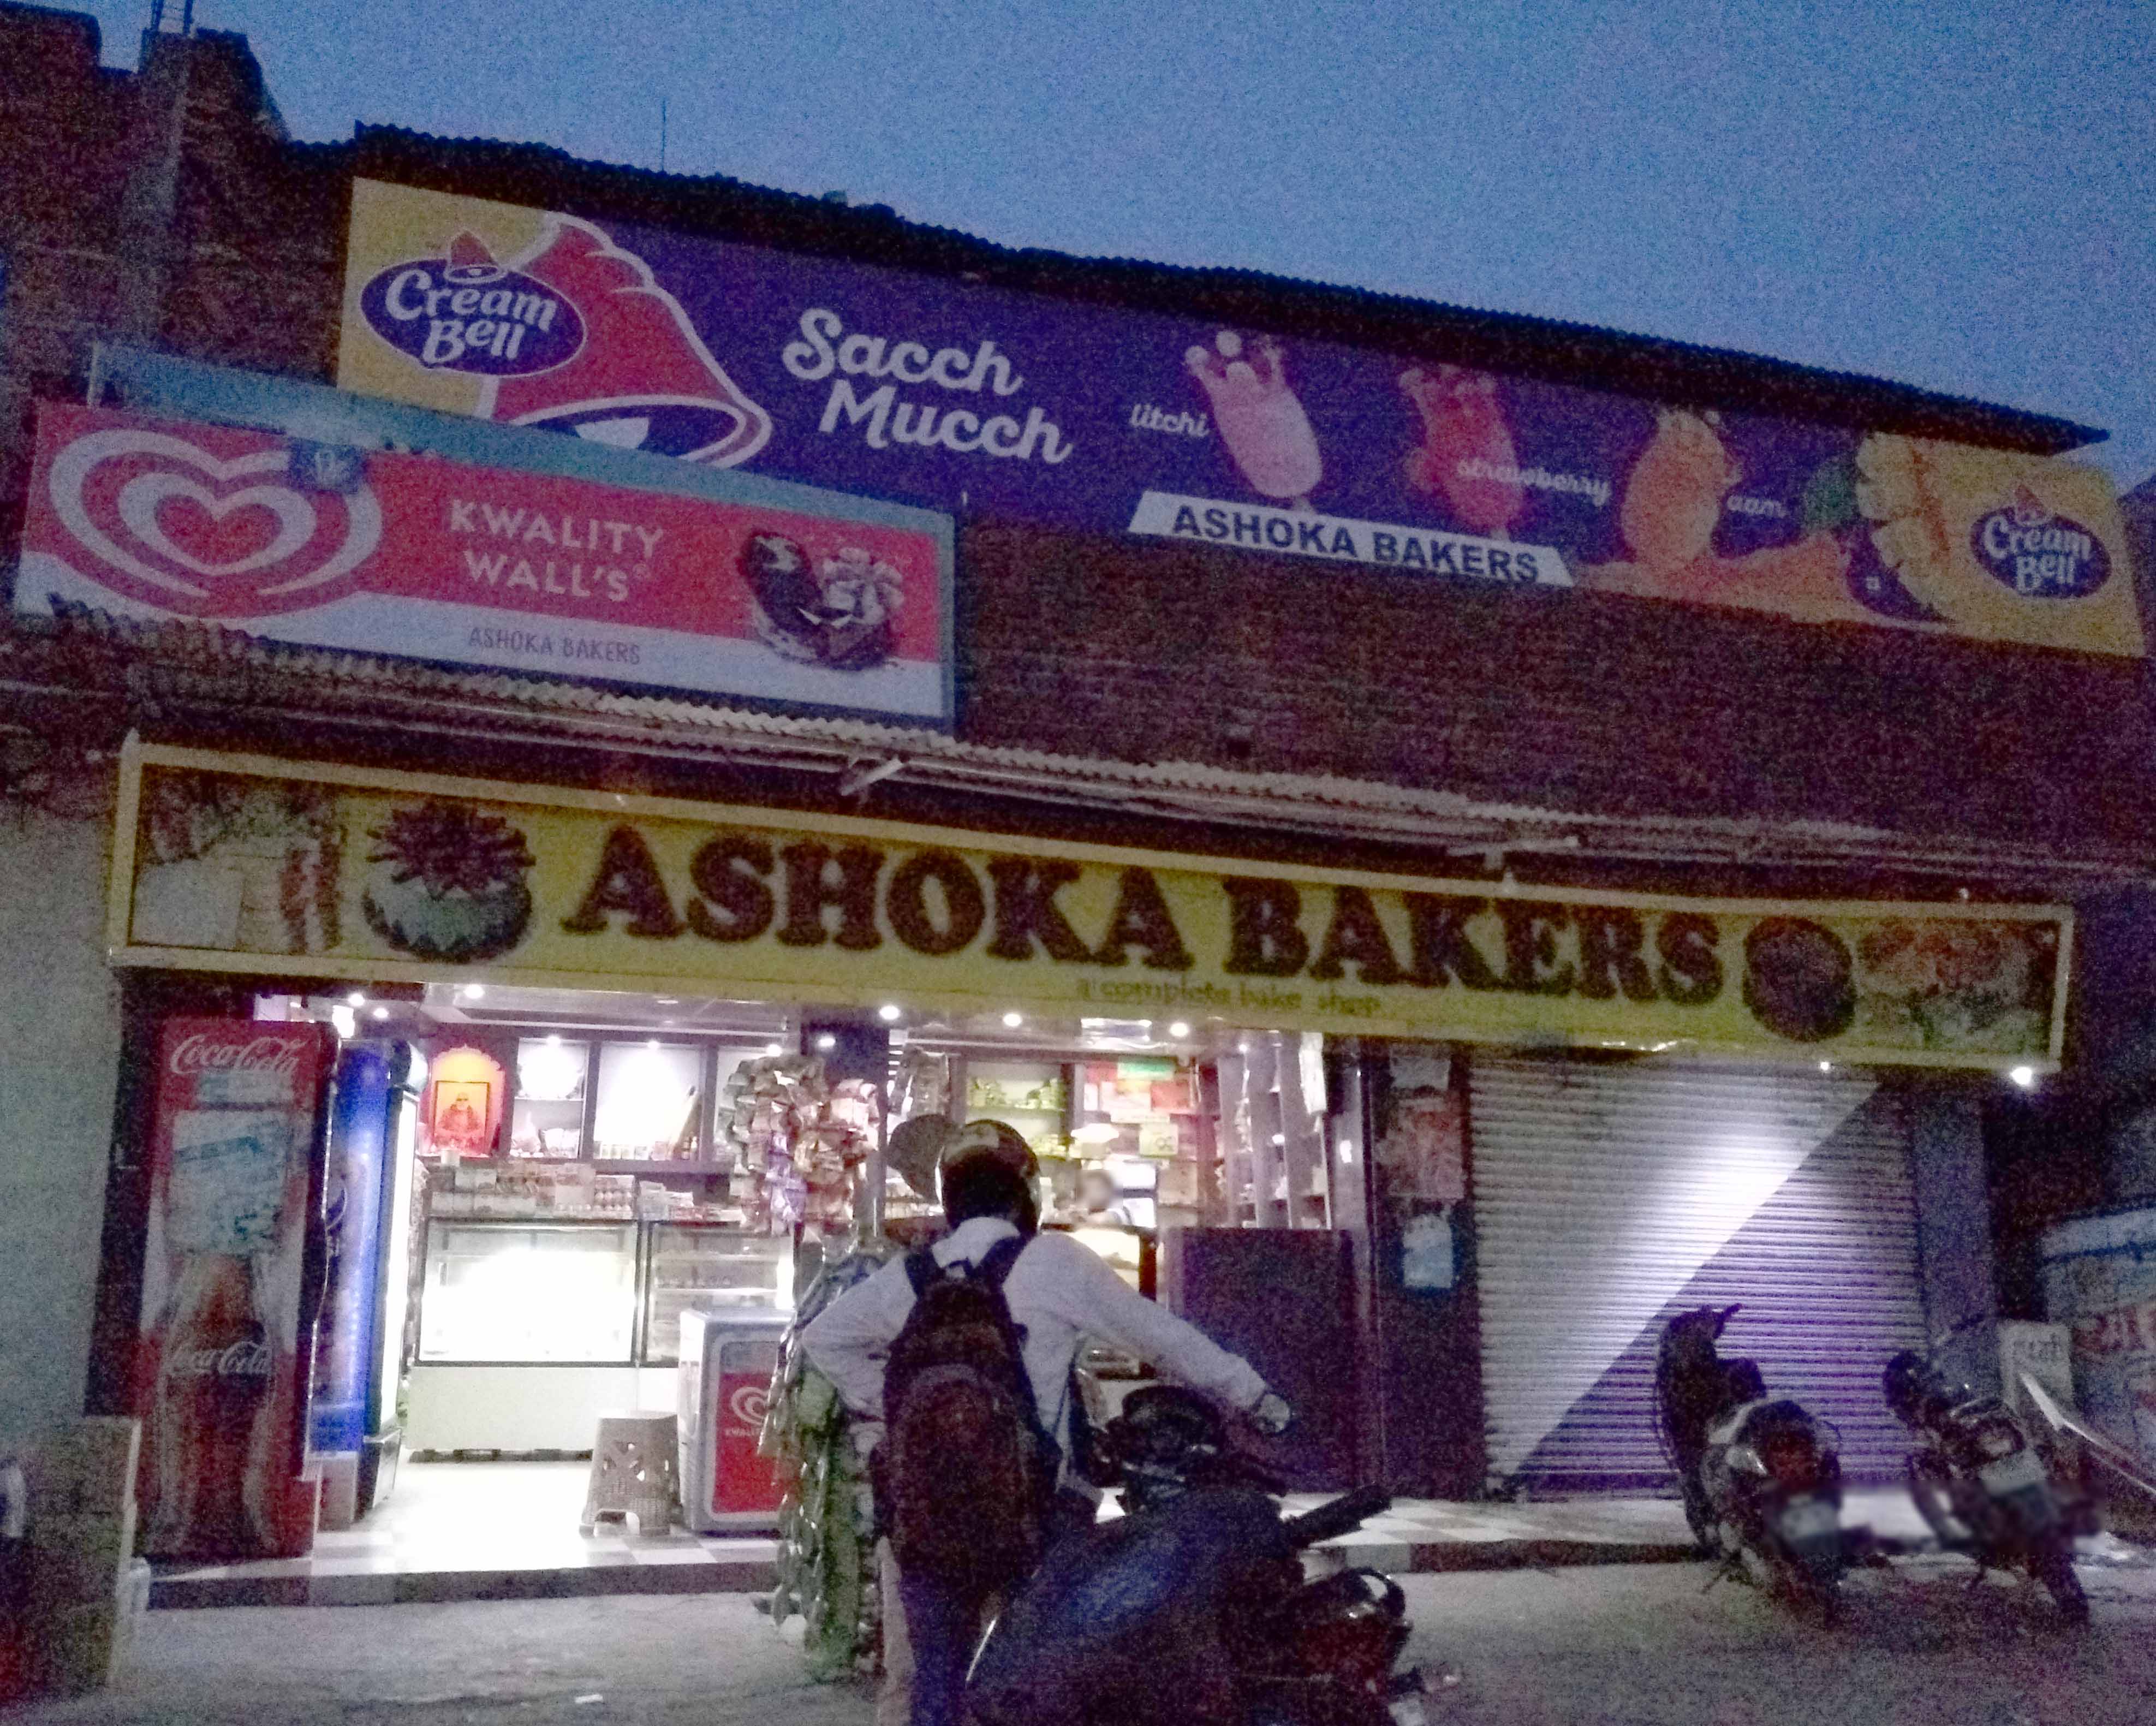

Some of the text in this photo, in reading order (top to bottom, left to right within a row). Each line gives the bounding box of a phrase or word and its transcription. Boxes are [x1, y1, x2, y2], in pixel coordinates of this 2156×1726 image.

[386, 267, 557, 331] Cream
[423, 318, 525, 364] Bell
[782, 308, 1023, 396] Sacch
[818, 379, 1073, 463] Mucch
[1129, 403, 1210, 438] litchi
[449, 499, 664, 558] KWALITY
[1171, 504, 1538, 583] ASHOKA BAKERS
[1982, 514, 2092, 561] Cream
[464, 549, 628, 602] WALL'S
[2015, 553, 2076, 593] Bell
[467, 626, 641, 665] ASHOKA BAKERS
[559, 822, 1725, 1005] ASHOKA BAKERS
